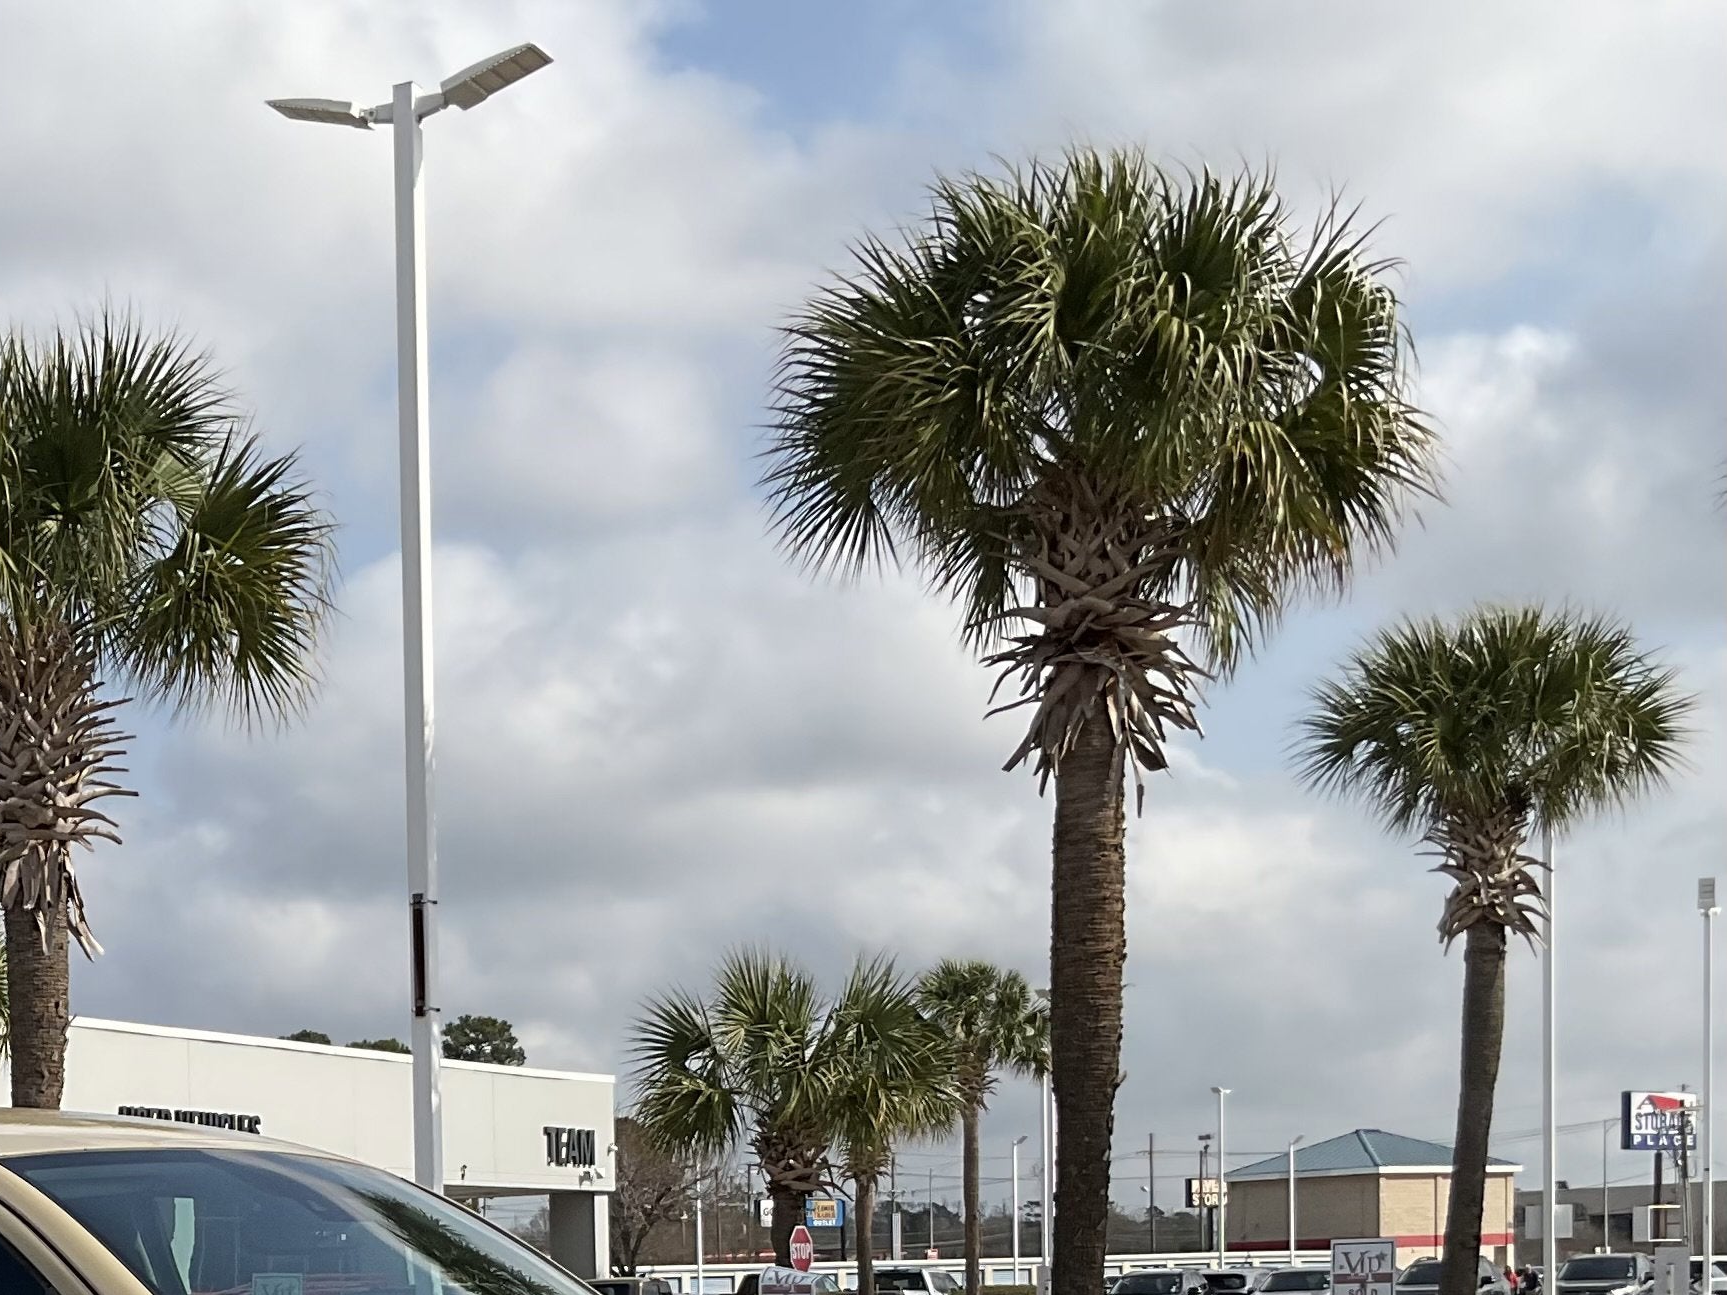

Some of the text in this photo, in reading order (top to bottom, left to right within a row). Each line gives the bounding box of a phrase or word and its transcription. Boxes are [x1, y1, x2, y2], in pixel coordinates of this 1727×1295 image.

[542, 1126, 595, 1167] TEAM
[1633, 1134, 1694, 1146] PLACE
[792, 1243, 812, 1260] STOP
